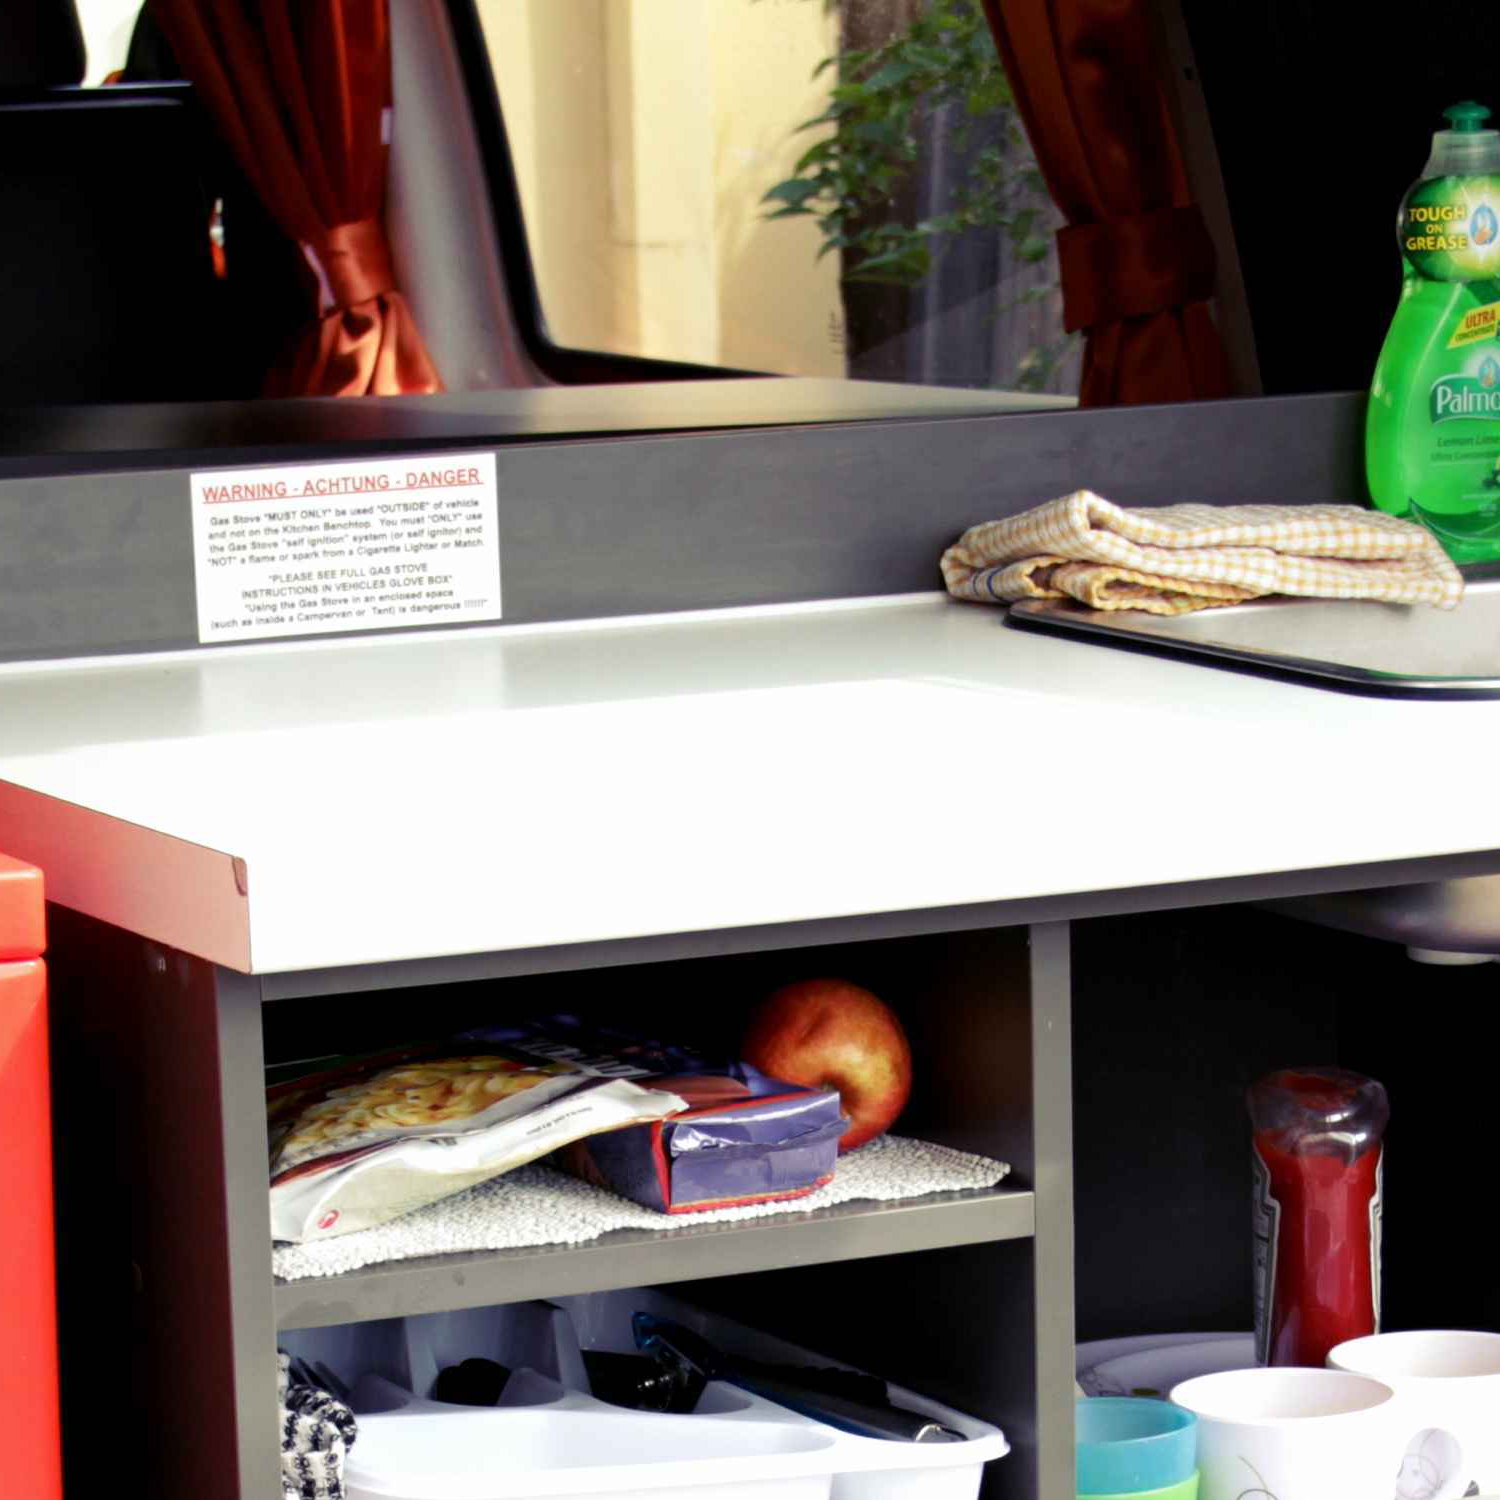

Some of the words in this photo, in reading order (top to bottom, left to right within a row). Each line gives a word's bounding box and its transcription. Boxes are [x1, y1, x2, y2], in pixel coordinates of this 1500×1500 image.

[1409, 206, 1466, 221] TOUGH
[1426, 223, 1444, 234] ON
[1405, 235, 1467, 250] GREASE
[202, 481, 287, 501] WARNING
[303, 474, 389, 497] ACHTUNG
[405, 468, 480, 488] DANGER
[210, 516, 229, 526] Gas
[232, 514, 260, 525] Stove
[334, 508, 346, 517] be
[350, 506, 374, 516] used
[432, 501, 443, 510] of
[446, 499, 479, 508] vehicle
[208, 530, 226, 540] and
[229, 529, 245, 538] not
[250, 529, 261, 537] on
[263, 526, 279, 536] the
[282, 524, 320, 534] Kitchen
[379, 518, 397, 527] You
[400, 516, 425, 525] must
[465, 513, 483, 521] use
[209, 543, 225, 553] the
[228, 542, 247, 551] Gas
[251, 540, 278, 550] Stove
[353, 531, 387, 543] system
[407, 528, 424, 538] self
[465, 525, 483, 534] and
[249, 552, 275, 563] flame
[279, 553, 289, 561] or
[292, 548, 319, 561] spark
[322, 548, 345, 558] from
[356, 545, 401, 556] Cigarette
[404, 542, 438, 554] Lighter
[441, 541, 451, 549] or
[317, 569, 337, 580] SEE
[340, 567, 366, 579] FULL
[369, 565, 391, 576] GAS
[394, 562, 428, 574] STOVE
[242, 585, 319, 599] INSTRUCTIONS
[322, 583, 332, 593] IN
[336, 579, 386, 592] VEHICLES
[389, 576, 424, 588] GLOVE
[280, 601, 296, 610] the
[299, 599, 318, 608] Gas
[321, 597, 349, 606] Stove
[352, 595, 361, 604] in
[364, 594, 375, 603] an
[378, 591, 422, 601] enclosed
[425, 590, 454, 600] space
[241, 618, 252, 626] as
[255, 615, 285, 625] inside
[297, 609, 353, 622] Campervan
[355, 609, 366, 617] or
[399, 605, 407, 613] is
[410, 602, 461, 613] dangerous
